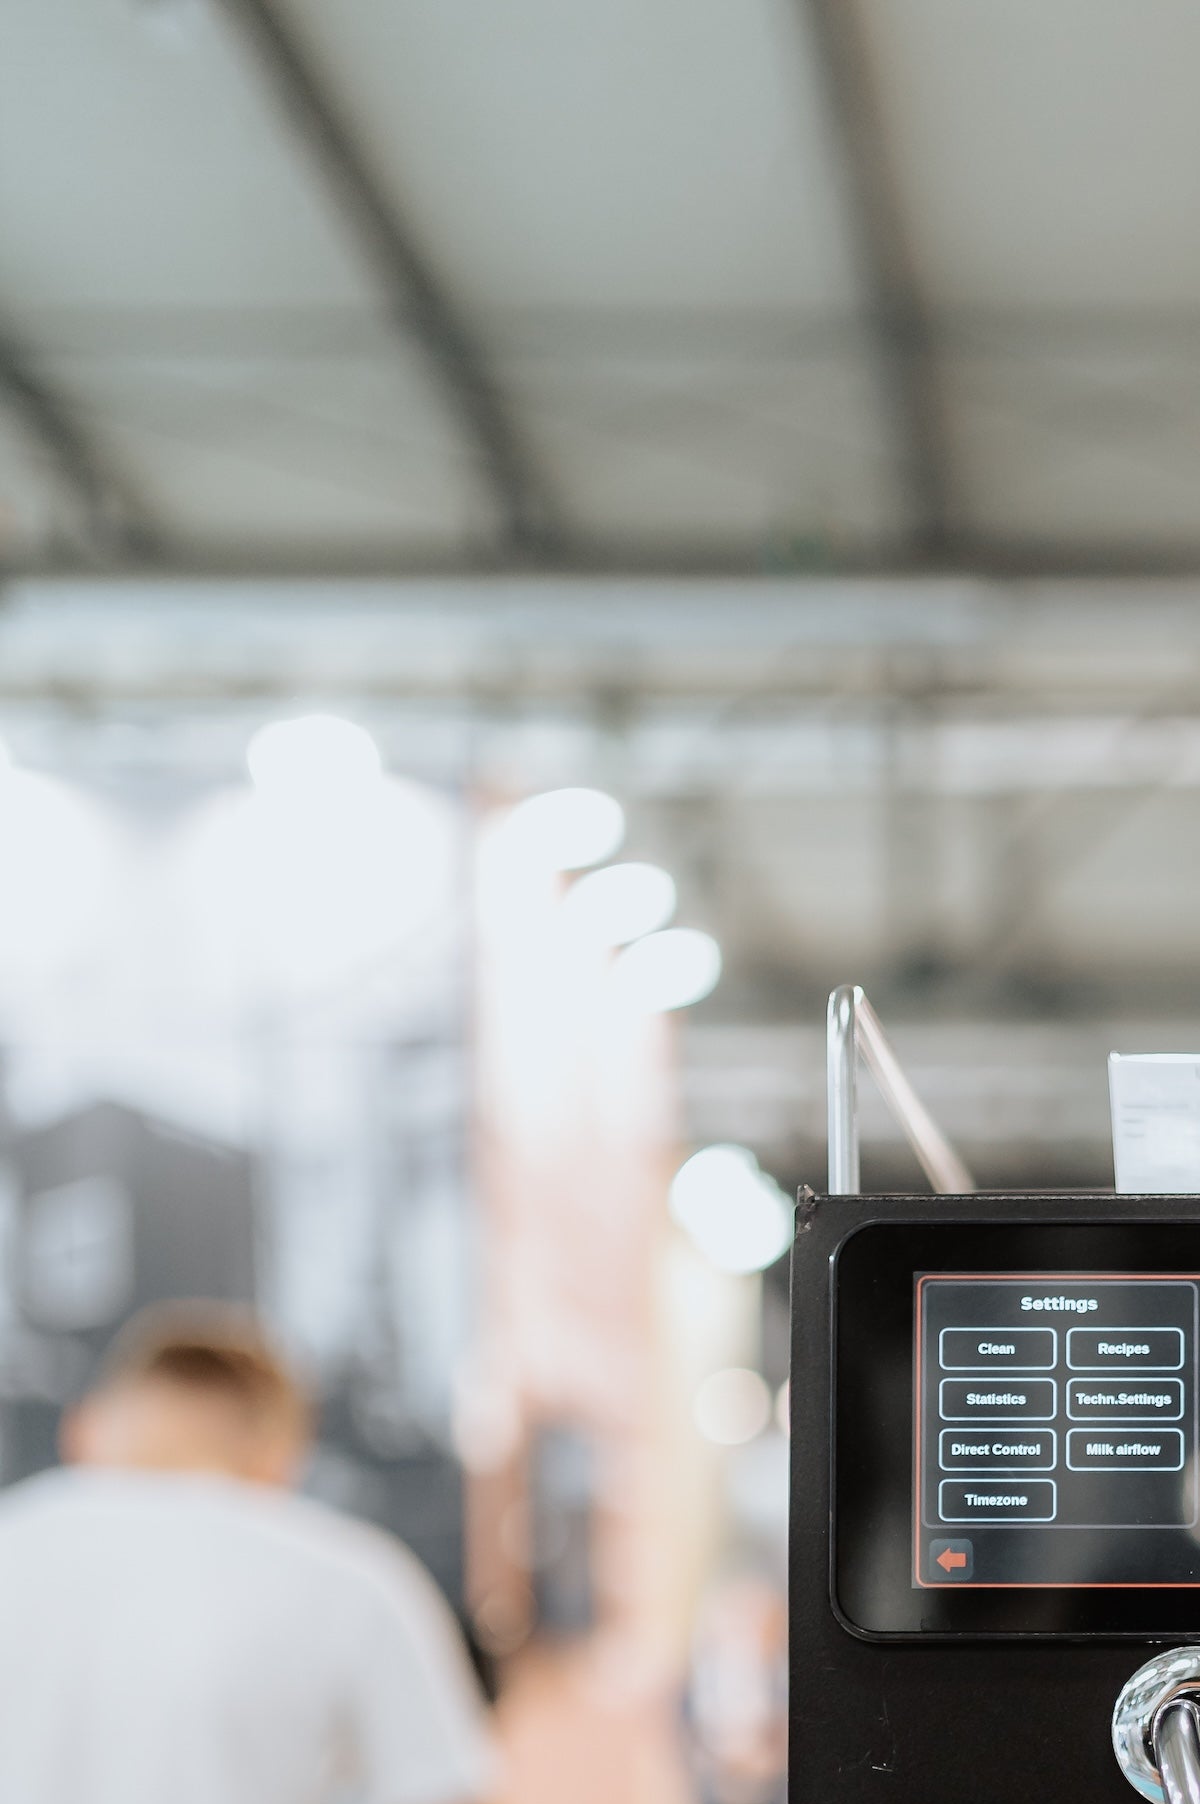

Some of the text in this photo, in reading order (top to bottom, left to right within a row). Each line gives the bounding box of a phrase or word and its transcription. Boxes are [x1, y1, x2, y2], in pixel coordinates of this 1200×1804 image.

[1020, 1296, 1099, 1314] Settings
[977, 1342, 1016, 1356] Clean
[1097, 1342, 1151, 1358] Recipes
[966, 1392, 1027, 1406] Statistics
[1075, 1392, 1172, 1408] Techn.Settings
[951, 1442, 1041, 1456] Direct Control
[1086, 1442, 1162, 1456] Milk airflow
[964, 1493, 1029, 1507] Timezone
